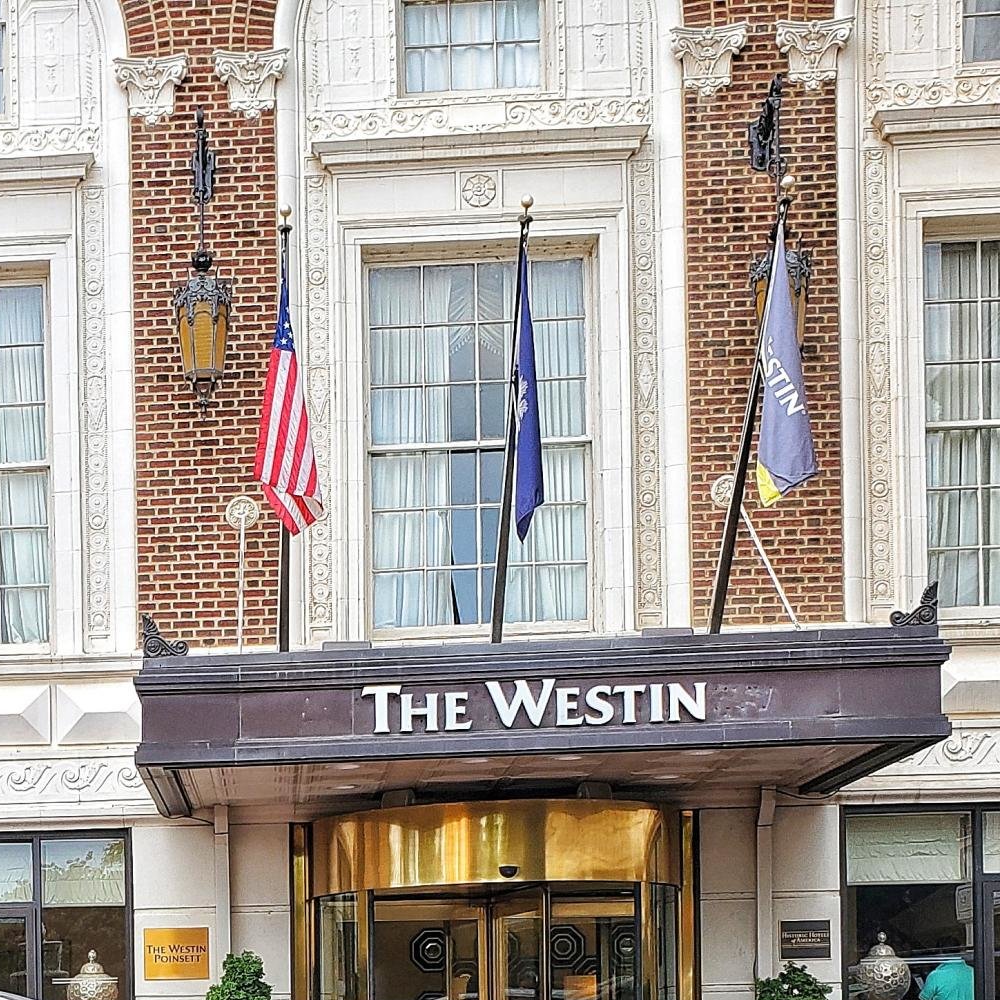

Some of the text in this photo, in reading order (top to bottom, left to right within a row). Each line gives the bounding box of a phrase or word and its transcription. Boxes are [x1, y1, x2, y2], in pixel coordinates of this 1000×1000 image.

[766, 336, 805, 417] STIN
[361, 677, 708, 734] THE WESTIN
[146, 944, 207, 954] THE WESTIN
[154, 954, 202, 963] POINSETT
